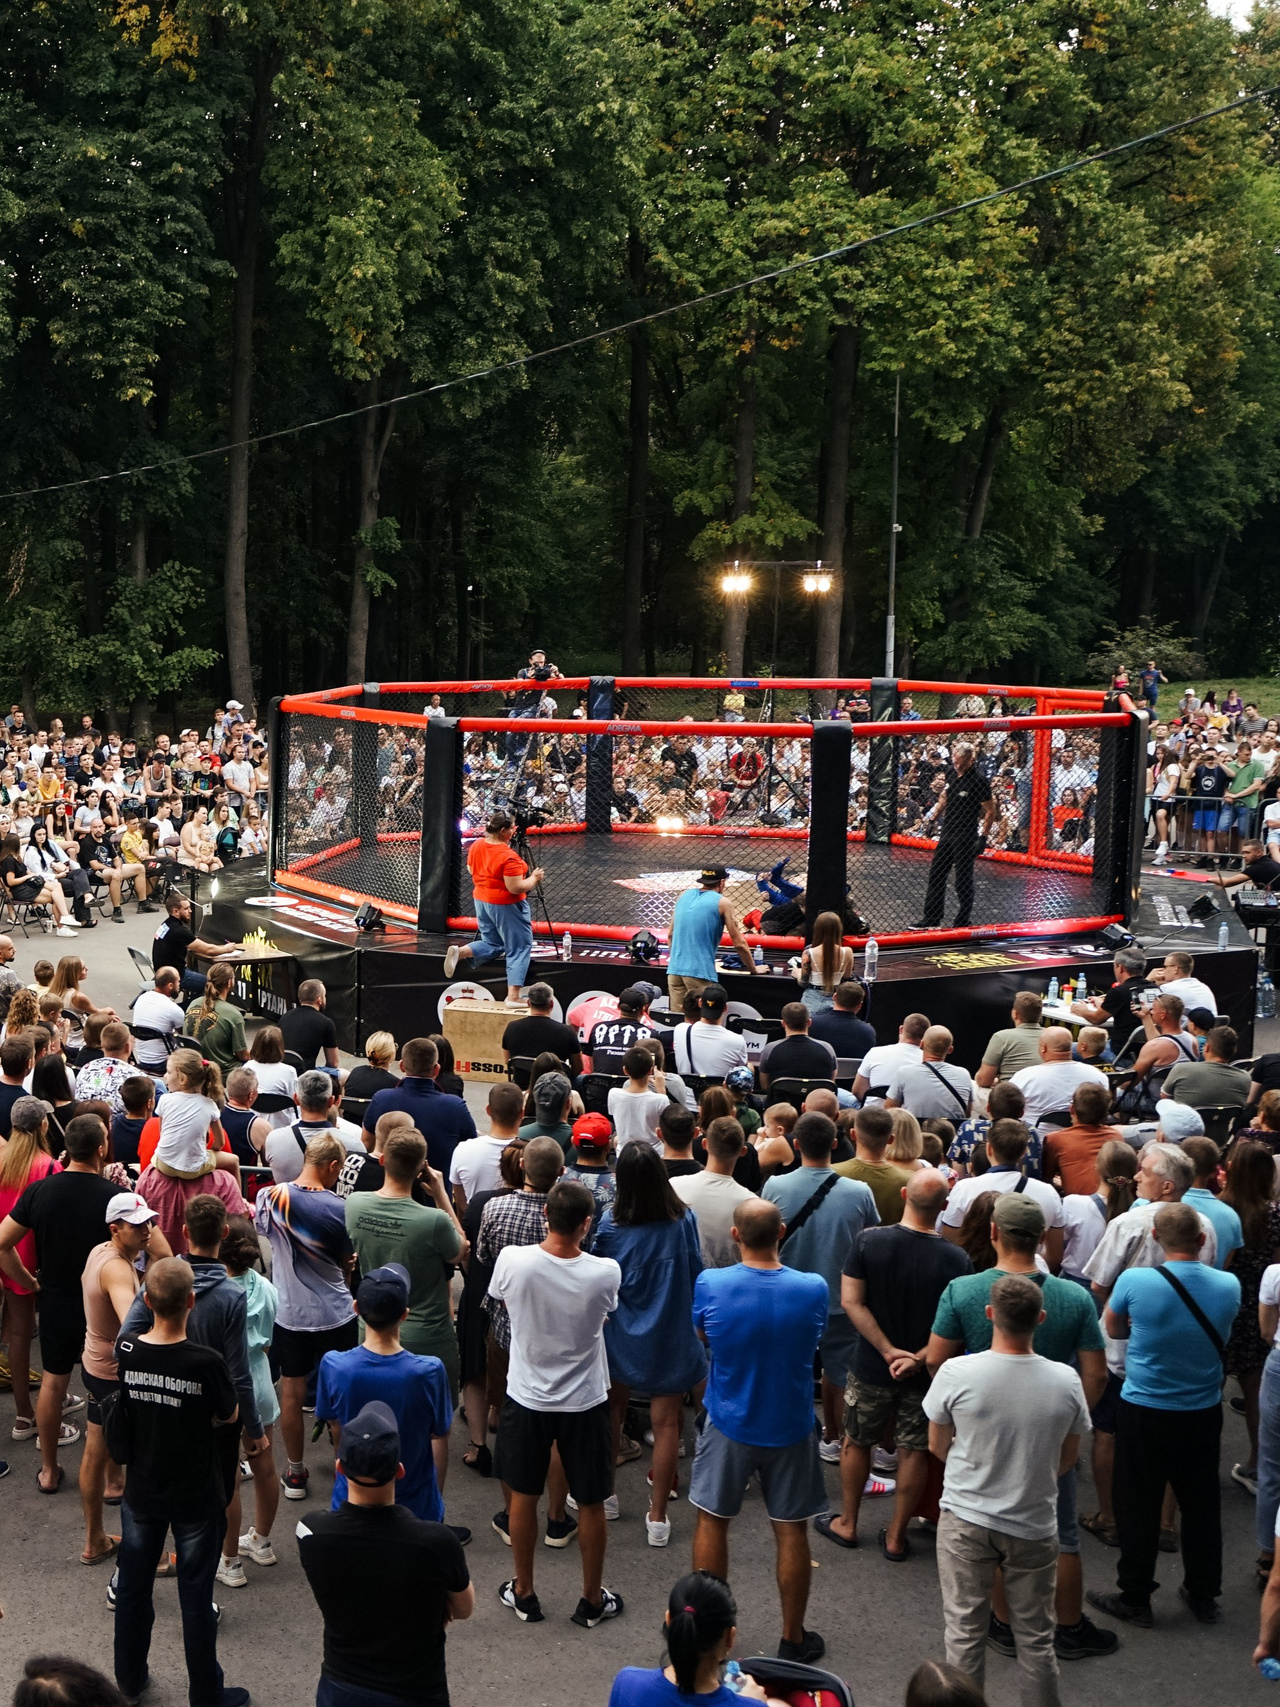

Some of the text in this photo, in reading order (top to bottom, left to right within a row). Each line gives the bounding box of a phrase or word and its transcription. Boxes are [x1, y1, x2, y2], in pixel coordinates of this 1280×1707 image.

[606, 724, 642, 732] ADEGMA
[453, 1060, 514, 1075] ossFi
[165, 1376, 202, 1395] ОБОРОНА
